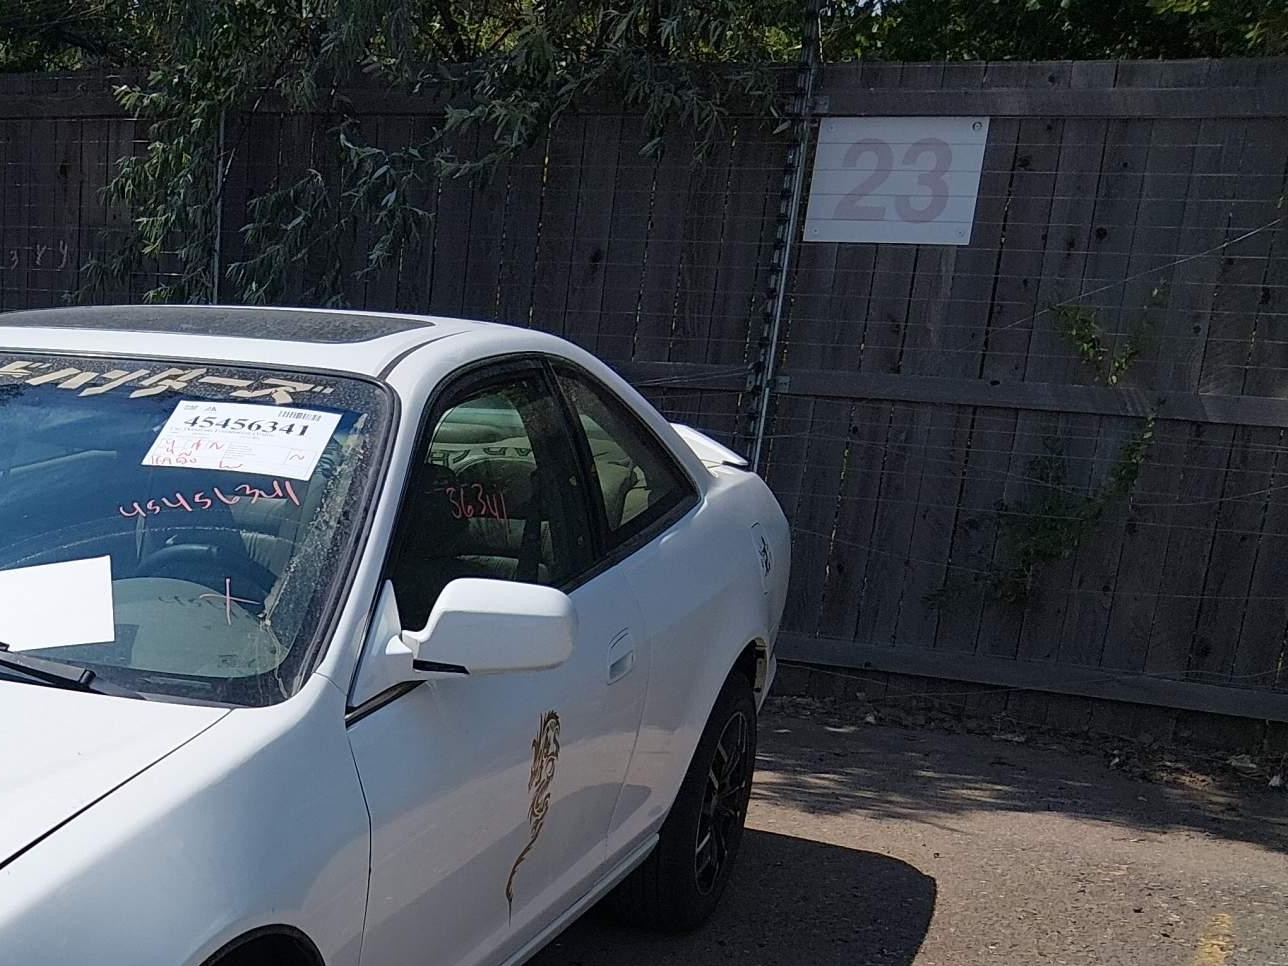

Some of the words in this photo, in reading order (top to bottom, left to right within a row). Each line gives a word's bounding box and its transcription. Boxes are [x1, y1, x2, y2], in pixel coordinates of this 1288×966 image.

[832, 137, 955, 224] 23
[183, 414, 311, 437] 45456341
[118, 479, 301, 518] 45456341
[444, 482, 509, 522] 36341
